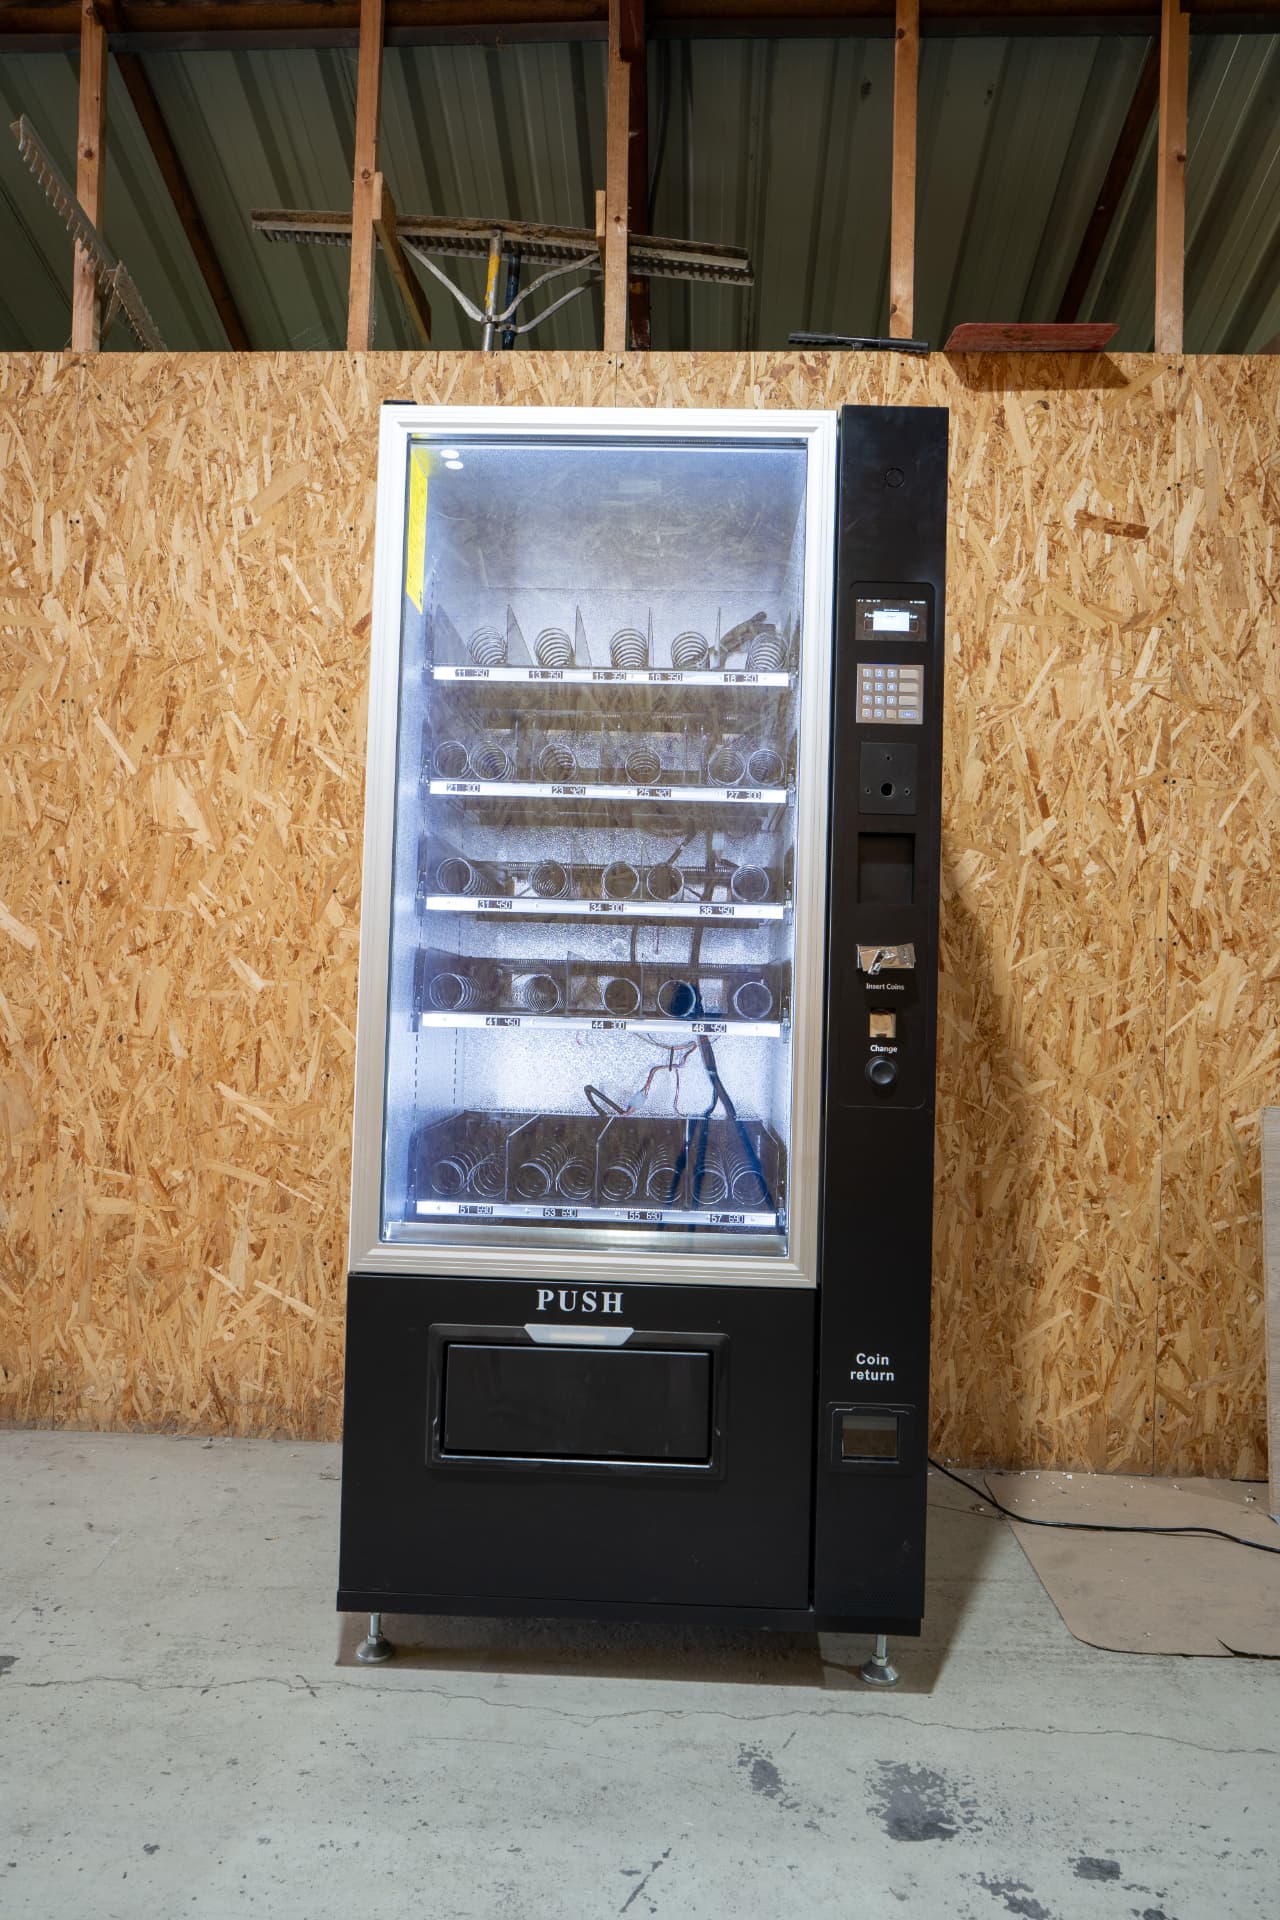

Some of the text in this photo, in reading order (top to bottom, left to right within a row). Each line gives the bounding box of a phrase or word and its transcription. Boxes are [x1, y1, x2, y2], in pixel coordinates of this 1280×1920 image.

[531, 671, 541, 679] 13
[594, 672, 605, 680] 15
[728, 791, 740, 799] 27
[479, 900, 511, 909] 31 450
[591, 903, 622, 912] 34 300
[701, 906, 733, 915] 36 450
[886, 983, 905, 991] Coins
[486, 1018, 519, 1026] 41 450
[592, 1021, 604, 1029] 44
[692, 1024, 704, 1032] 46
[870, 1044, 898, 1054] Change
[460, 1205, 470, 1213] 51
[544, 1208, 576, 1217] 53 690
[629, 1212, 661, 1220] 55 690
[711, 1214, 743, 1223] 57 690
[536, 1289, 624, 1313] PUSH
[856, 1352, 889, 1365] Coin
[850, 1369, 895, 1381] return
